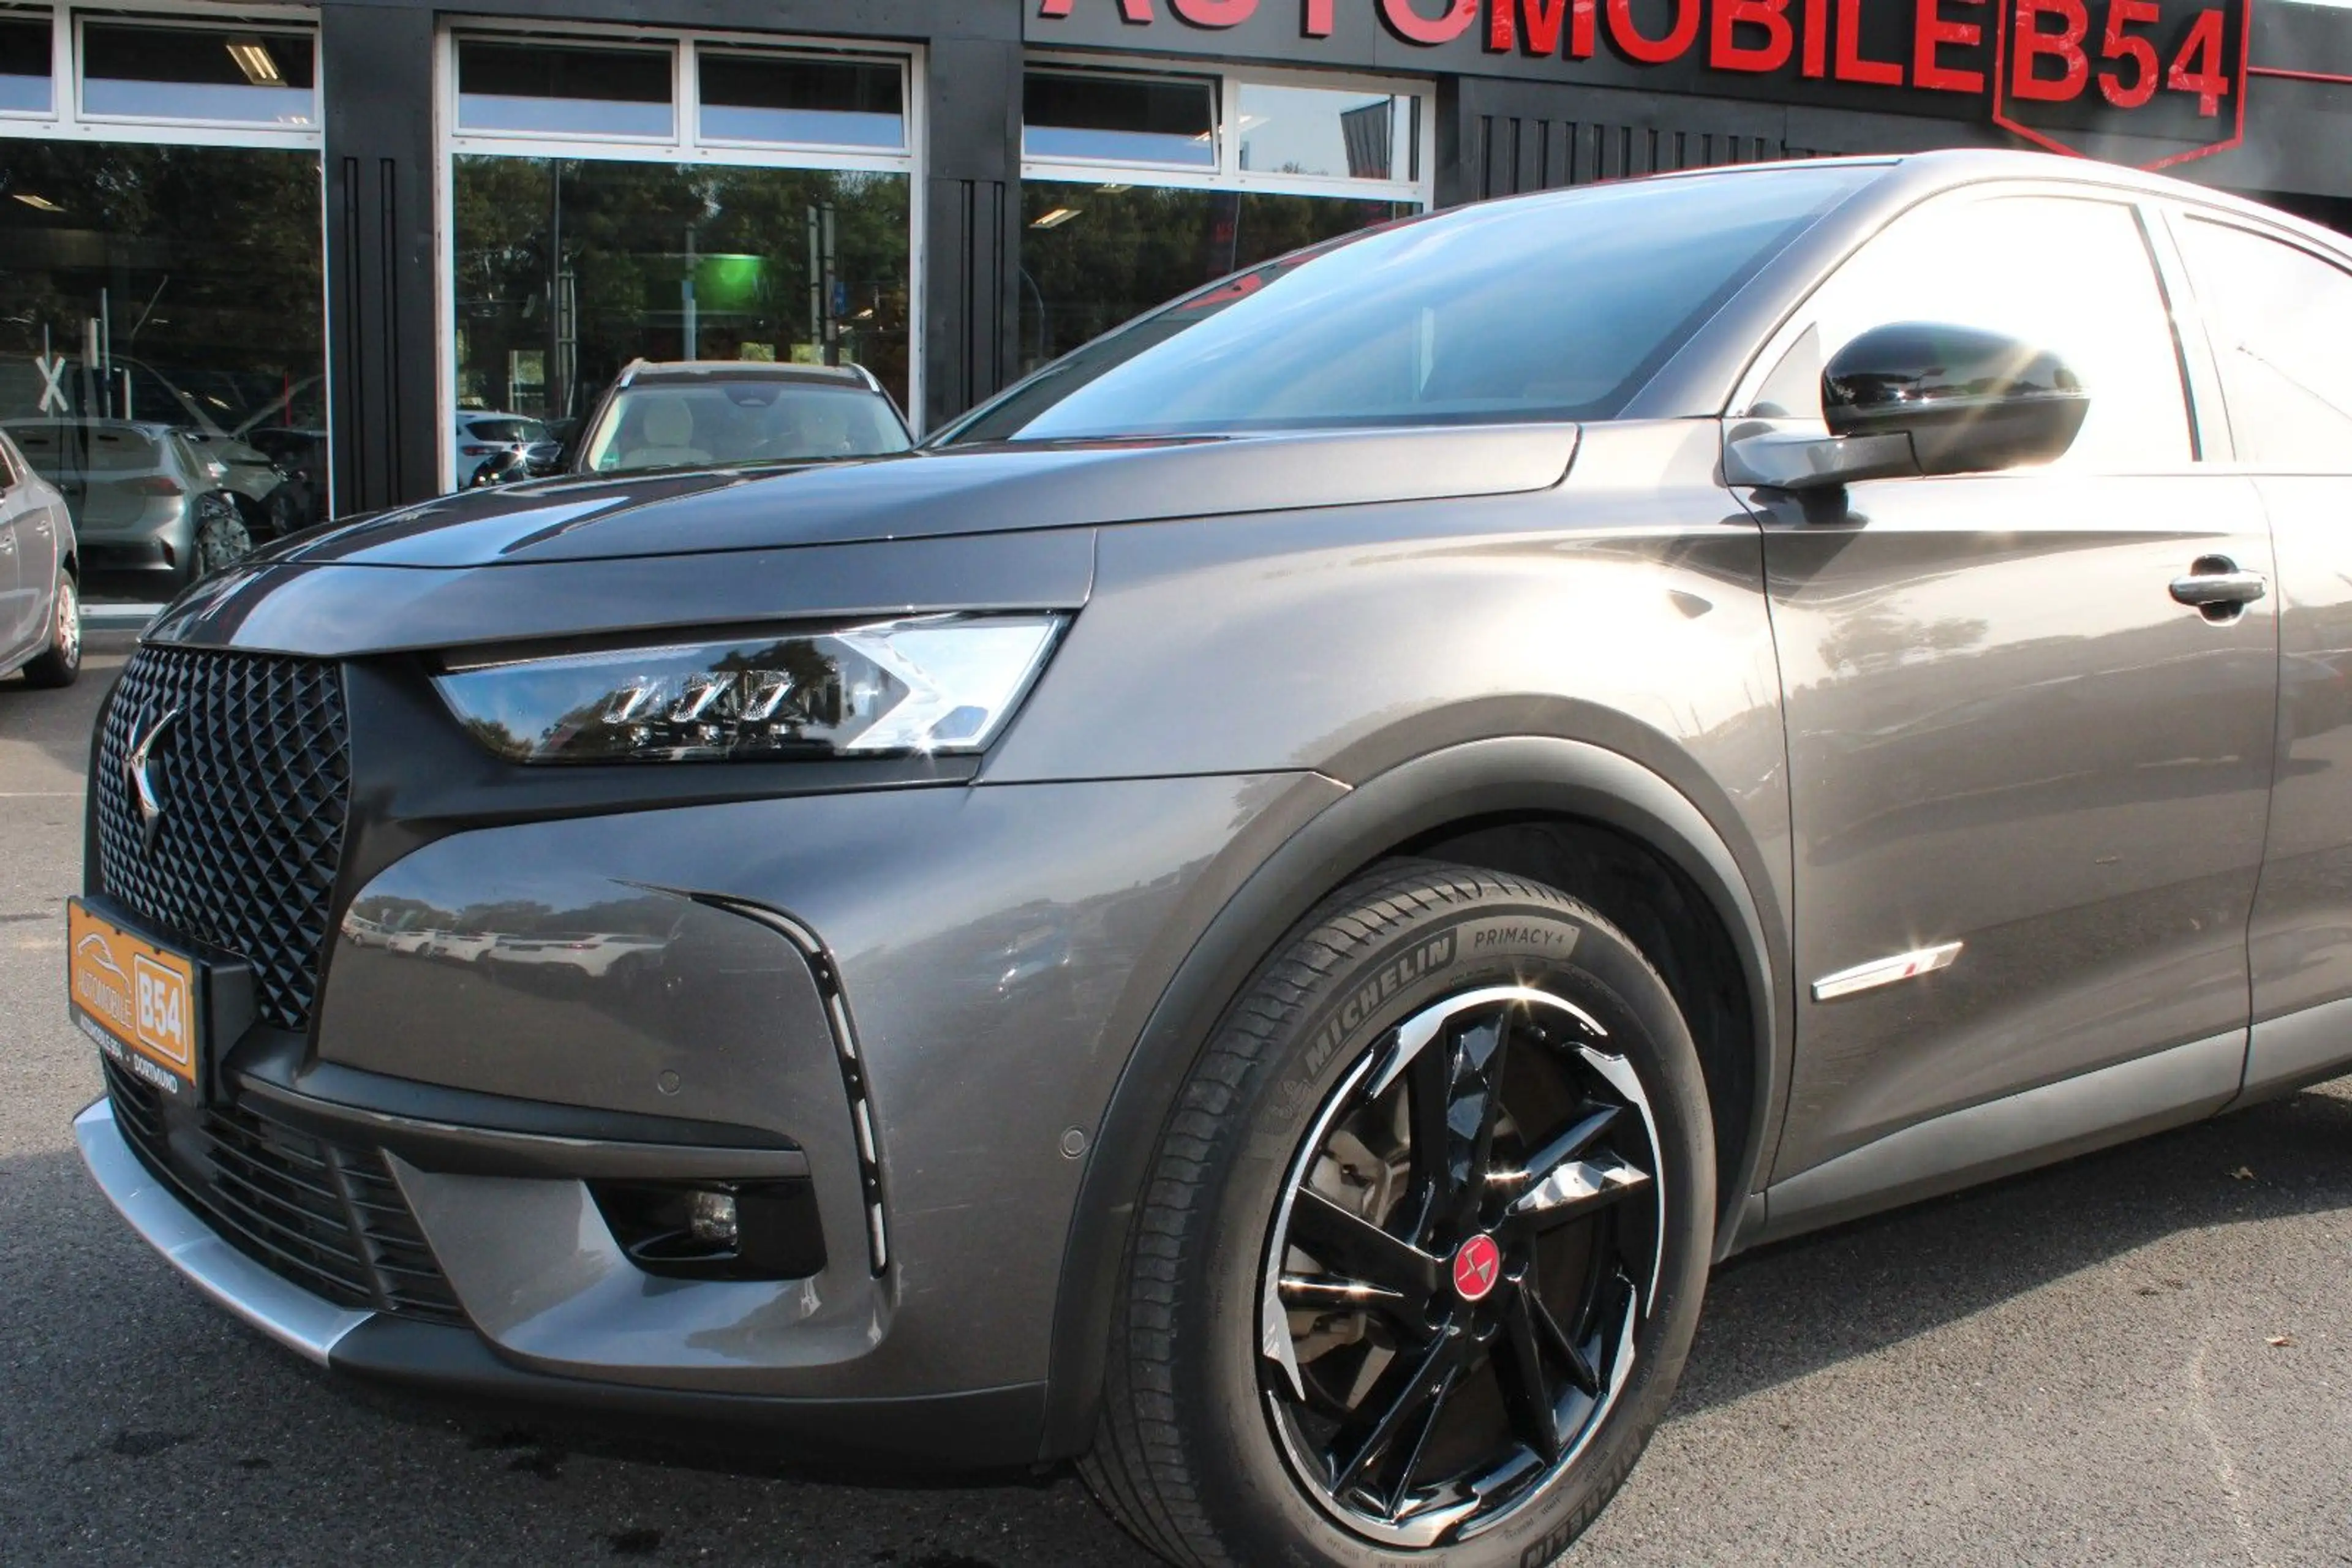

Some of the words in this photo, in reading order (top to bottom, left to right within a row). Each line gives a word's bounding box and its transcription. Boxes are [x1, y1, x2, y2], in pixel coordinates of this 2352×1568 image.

[1038, 0, 1985, 93] MOBILE
[2011, 0, 2228, 117] B54
[138, 971, 183, 1045] B54
[1305, 937, 1450, 1076] MICHELIN
[1474, 927, 1553, 948] PRIMACY
